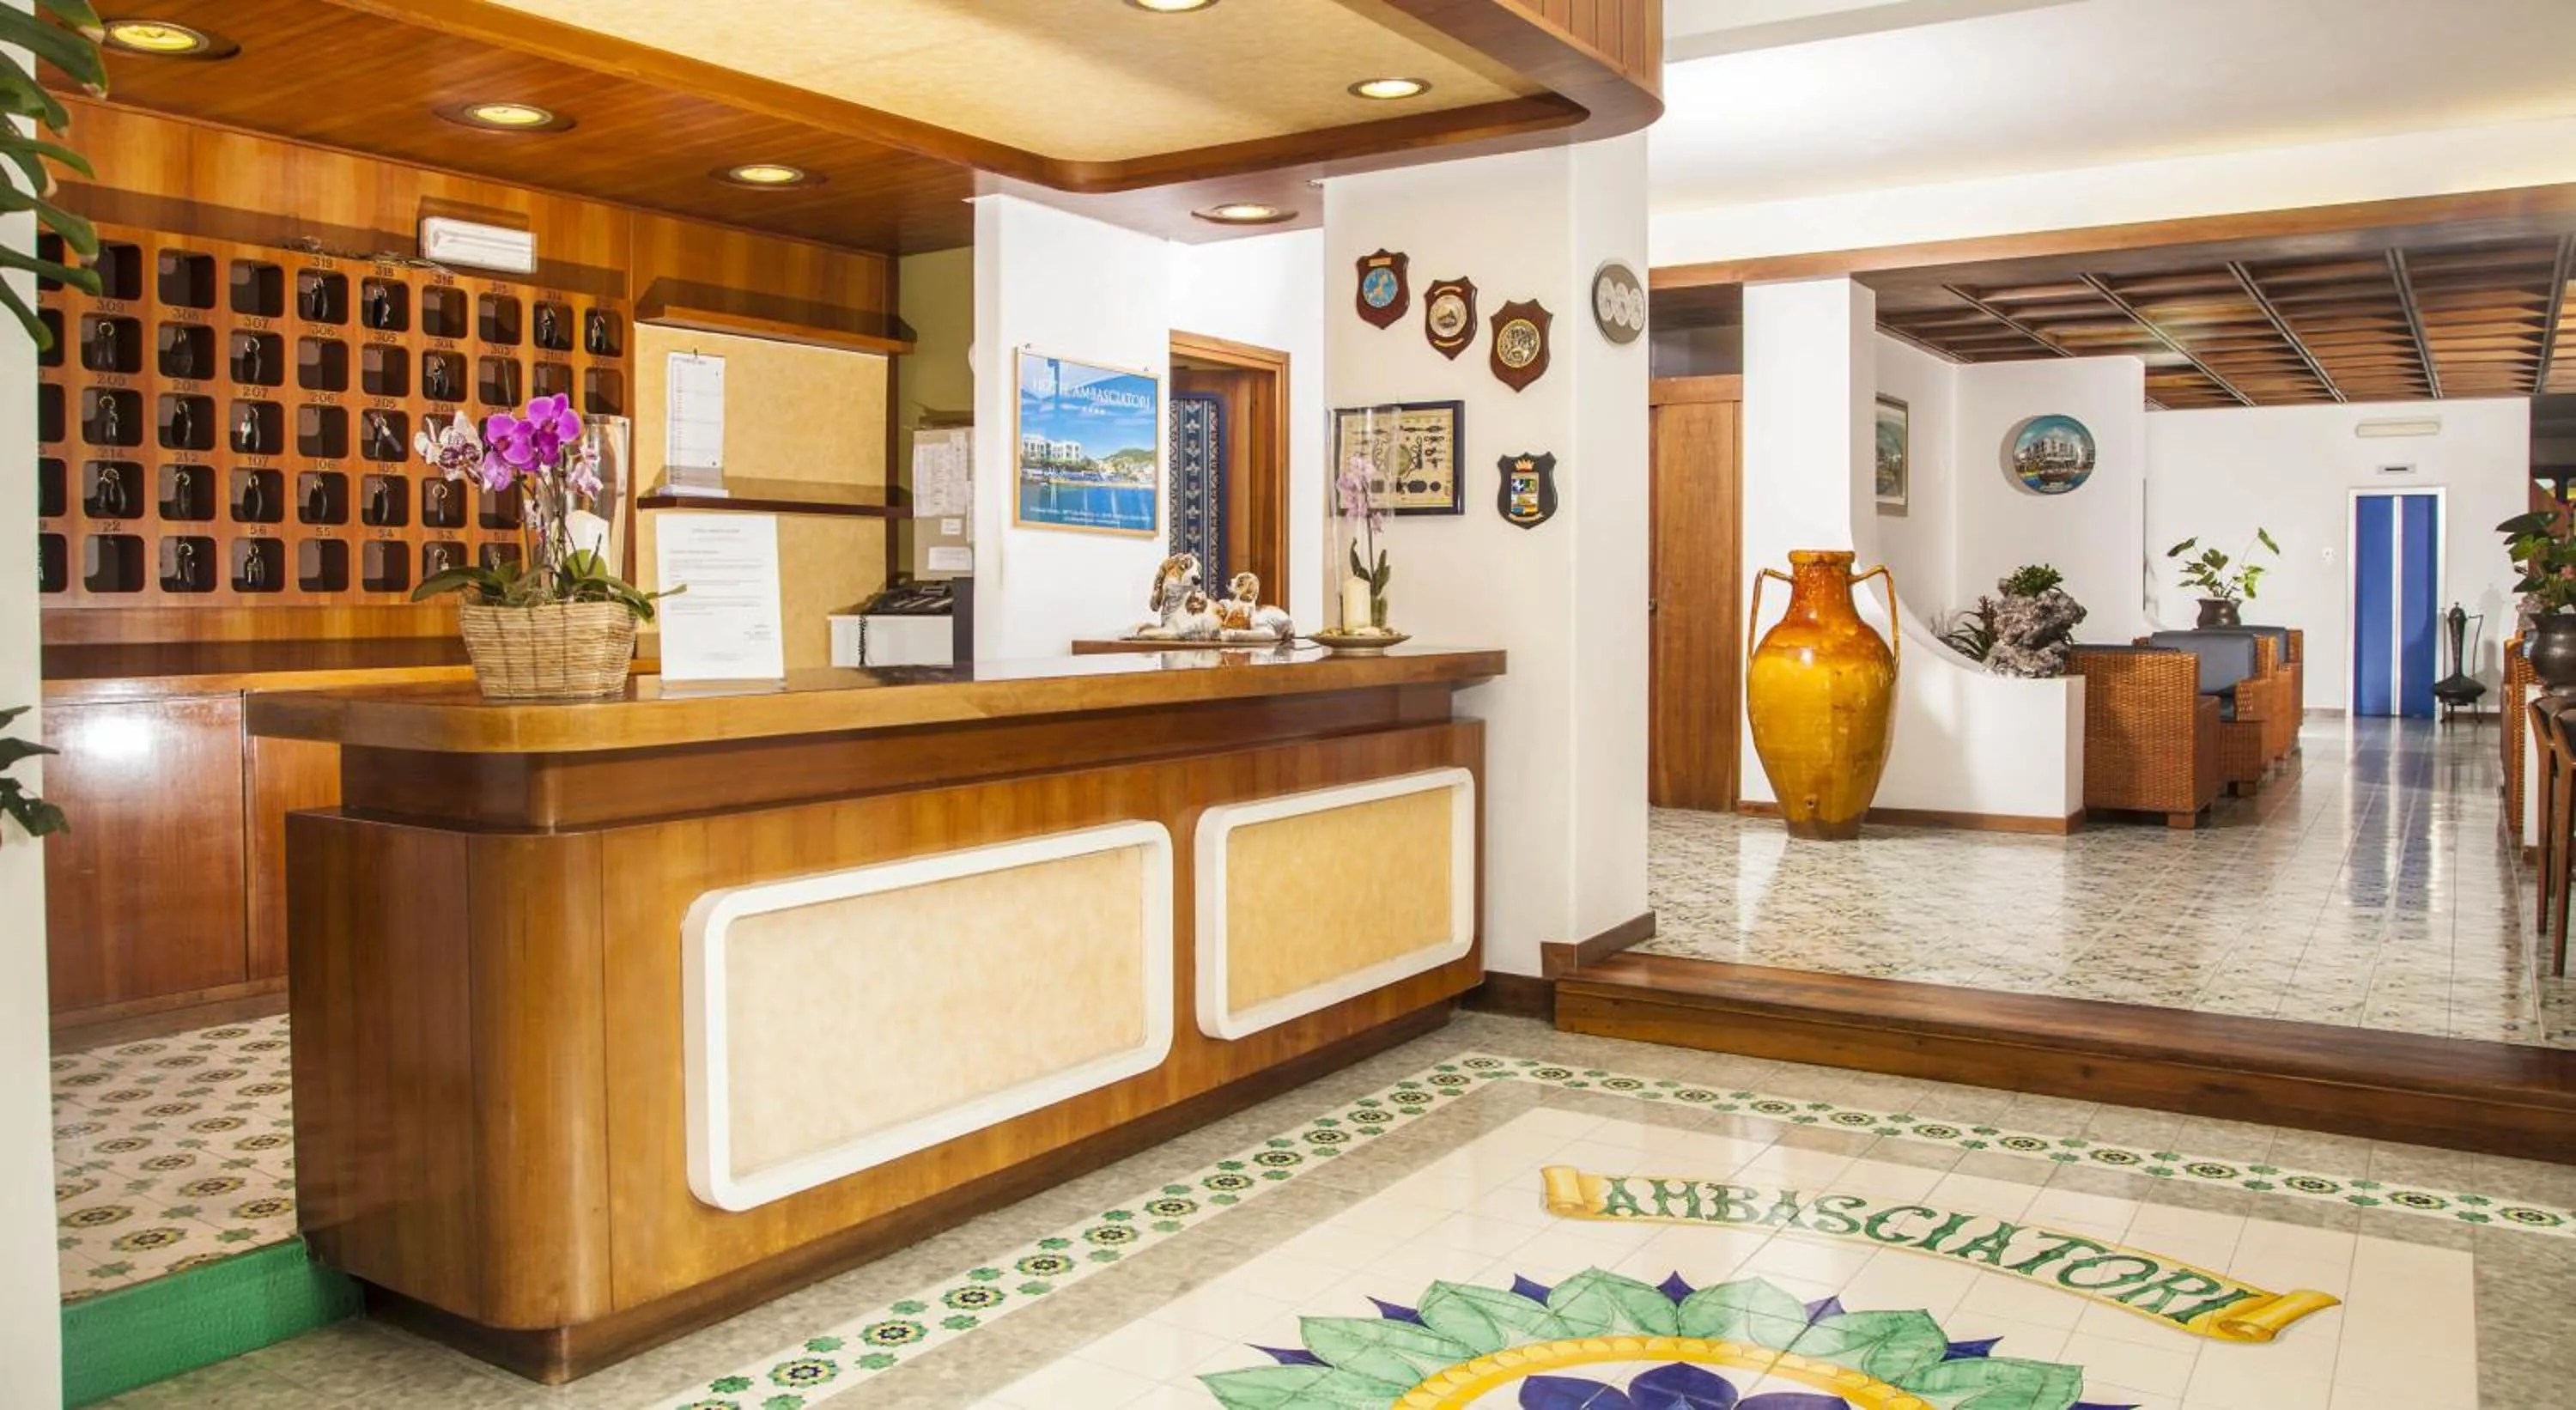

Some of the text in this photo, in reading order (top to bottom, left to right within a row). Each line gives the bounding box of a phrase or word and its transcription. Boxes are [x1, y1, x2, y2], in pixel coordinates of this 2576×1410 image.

[313, 257, 334, 269] 319
[434, 274, 453, 285] 316
[97, 300, 125, 312] 309
[244, 316, 270, 329] 307
[311, 325, 335, 337] 306
[374, 331, 397, 343] 305
[243, 386, 269, 398] 207
[310, 392, 335, 404] 206
[247, 456, 268, 467] 107
[1598, 1177, 2262, 1325] AMBASCIATORI
